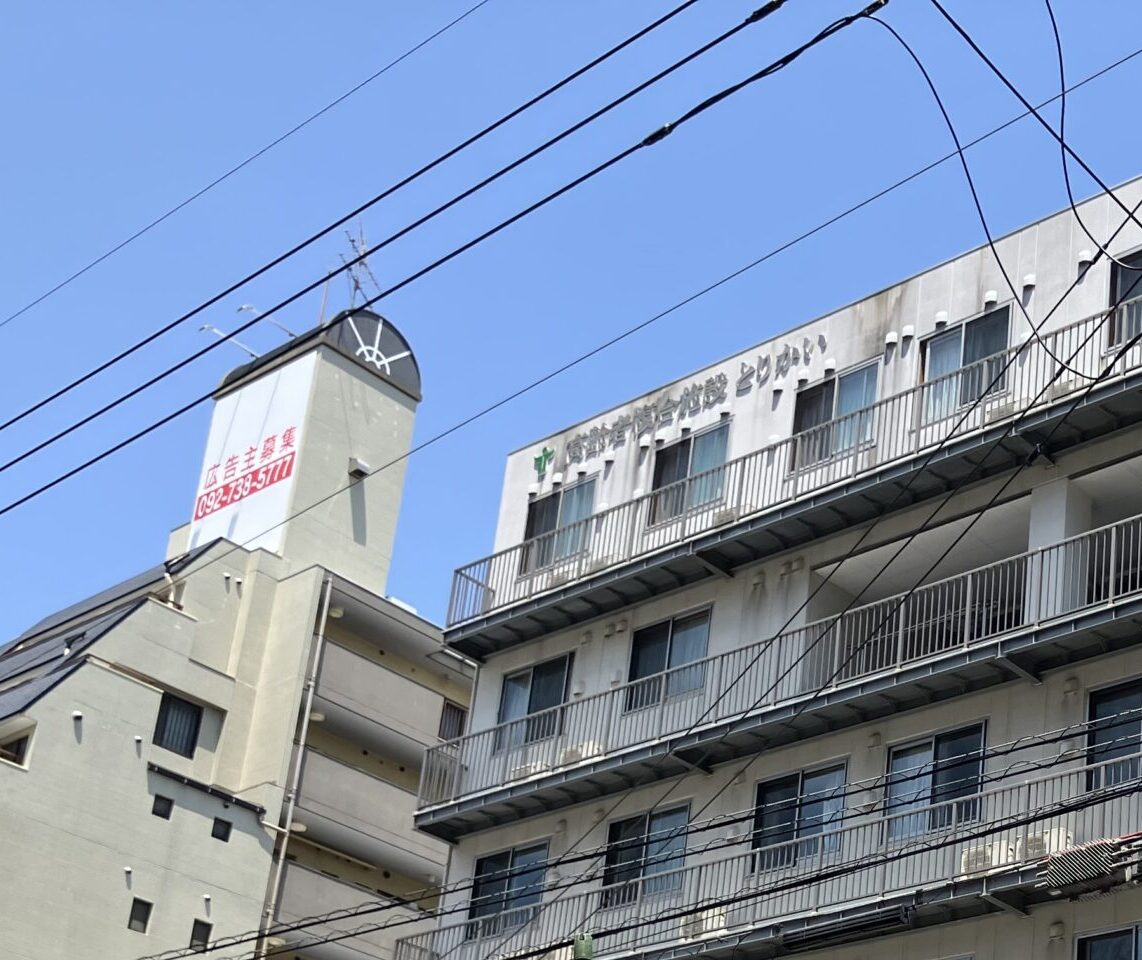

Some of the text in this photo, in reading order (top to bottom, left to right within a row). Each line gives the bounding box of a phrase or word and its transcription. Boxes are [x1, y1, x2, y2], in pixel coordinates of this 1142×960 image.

[198, 454, 292, 519] 092-738-5777
[203, 425, 297, 489] 広告主募集
